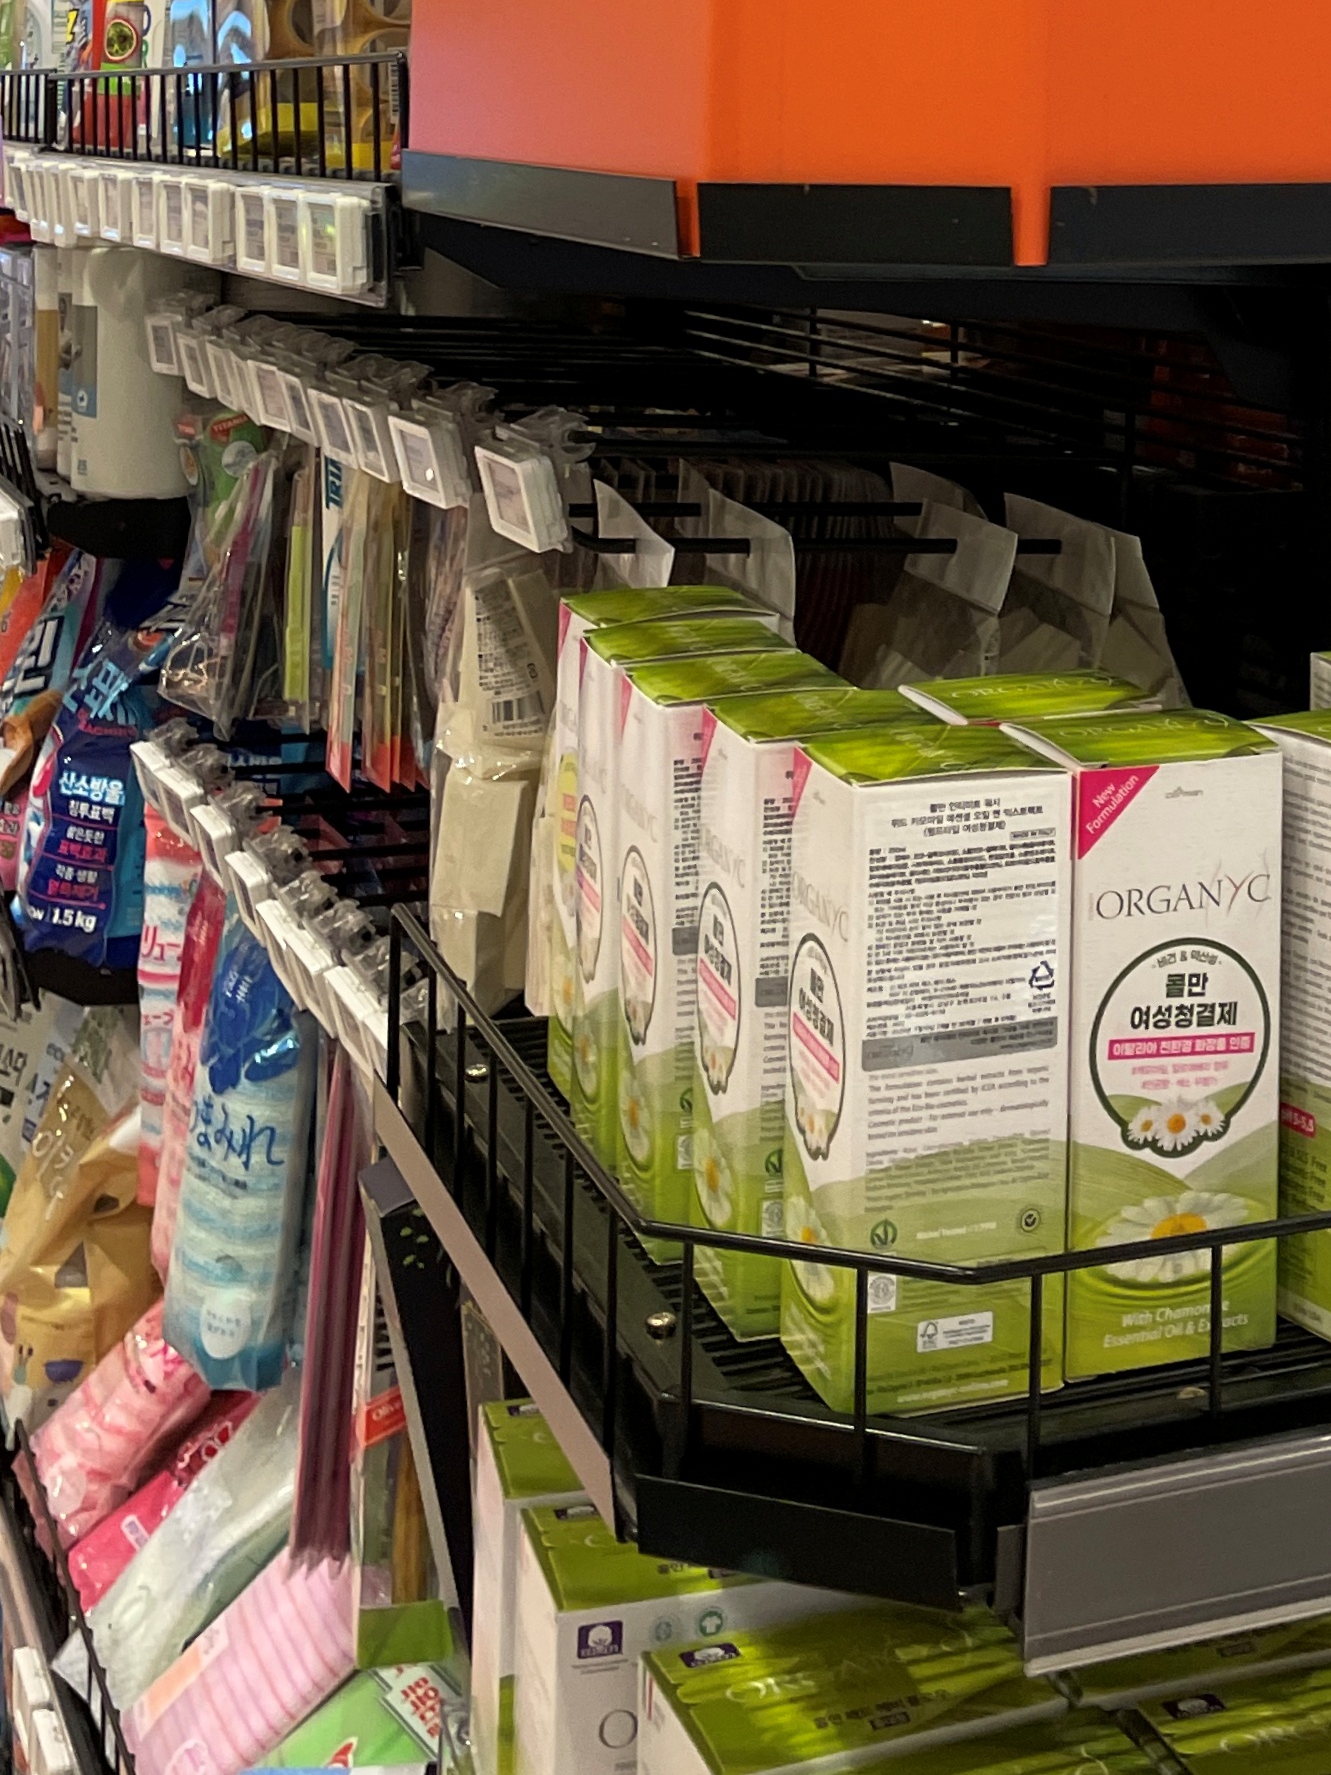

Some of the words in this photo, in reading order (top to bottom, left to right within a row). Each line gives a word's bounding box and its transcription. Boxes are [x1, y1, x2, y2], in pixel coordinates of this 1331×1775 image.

[58, 770, 126, 806] 산소방울
[1092, 782, 1117, 809] New
[68, 799, 116, 825] 침투표백
[1085, 774, 1140, 835] Formulation
[1095, 870, 1272, 919] ORGANYC
[1166, 972, 1209, 999] 콜만
[1130, 1001, 1238, 1030] 여성청결제
[1103, 1322, 1162, 1349] Essential
